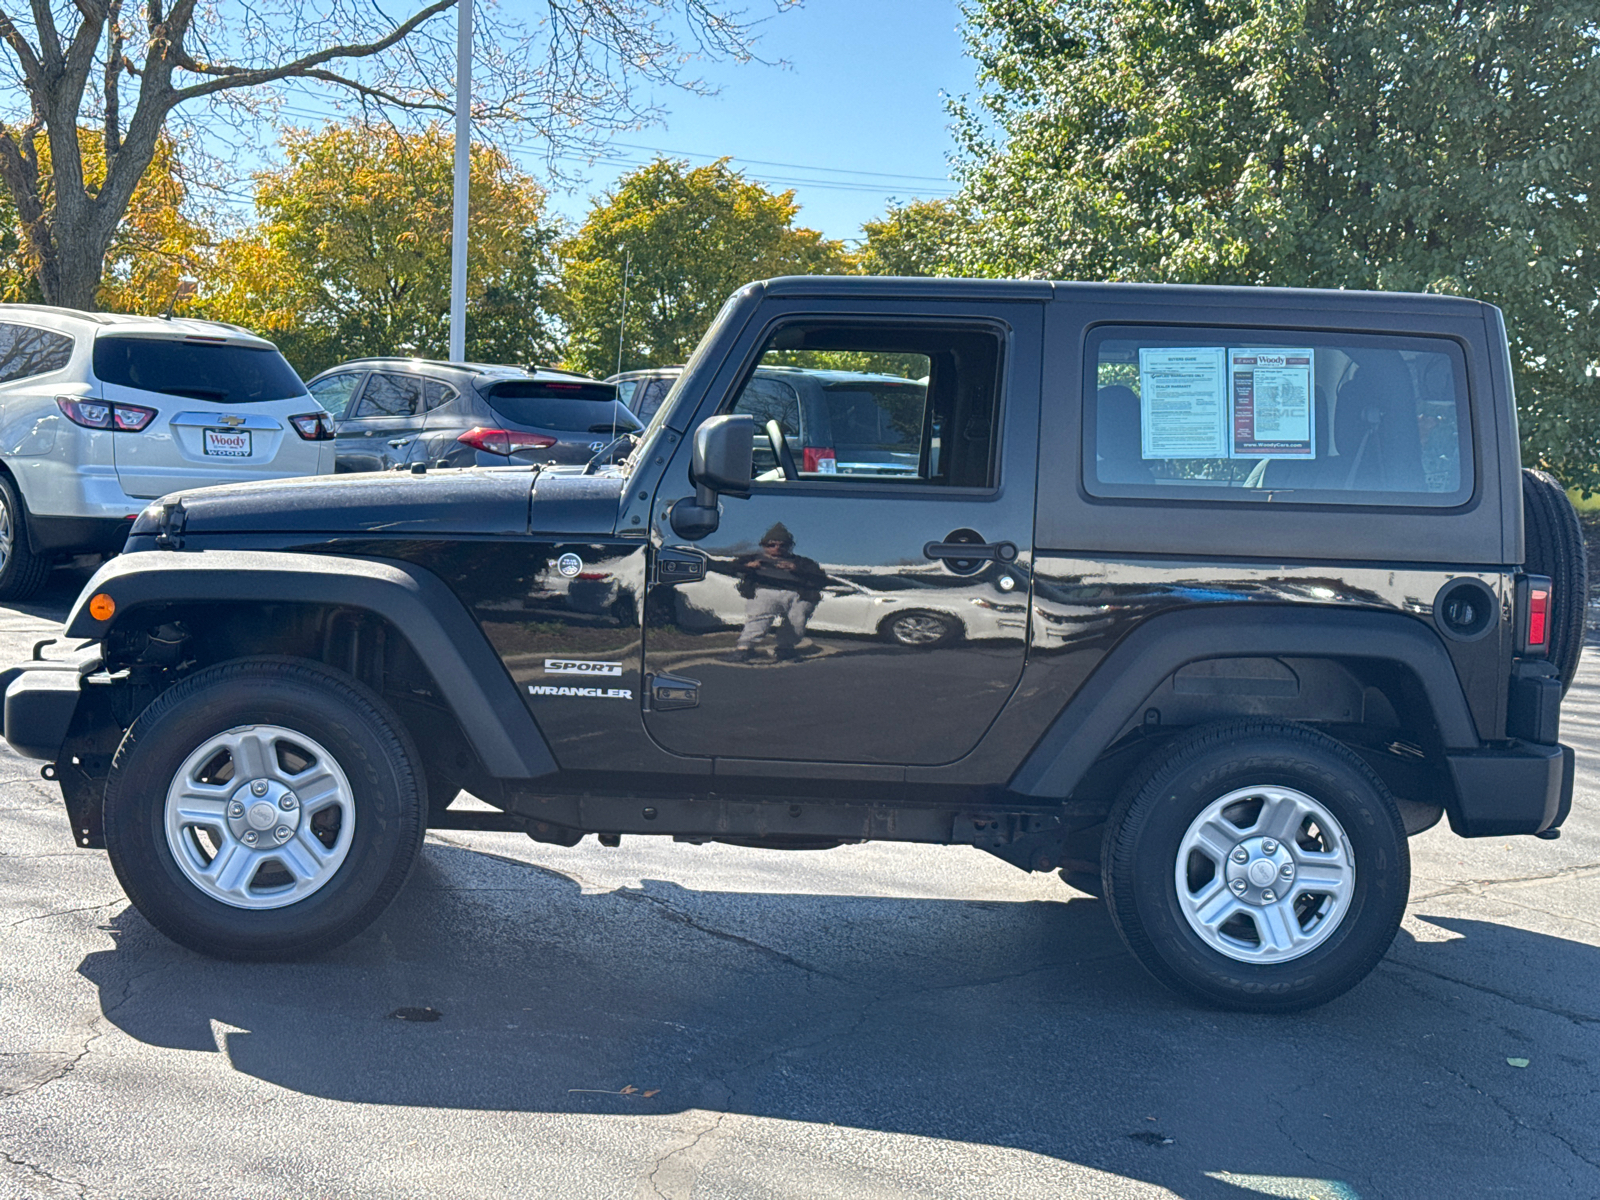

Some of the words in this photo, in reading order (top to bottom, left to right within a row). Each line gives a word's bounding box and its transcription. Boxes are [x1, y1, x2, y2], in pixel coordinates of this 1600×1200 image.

[1258, 356, 1285, 365] Woody
[209, 434, 246, 448] Woody
[547, 661, 620, 673] SPORT
[528, 685, 633, 700] WRANGLER
